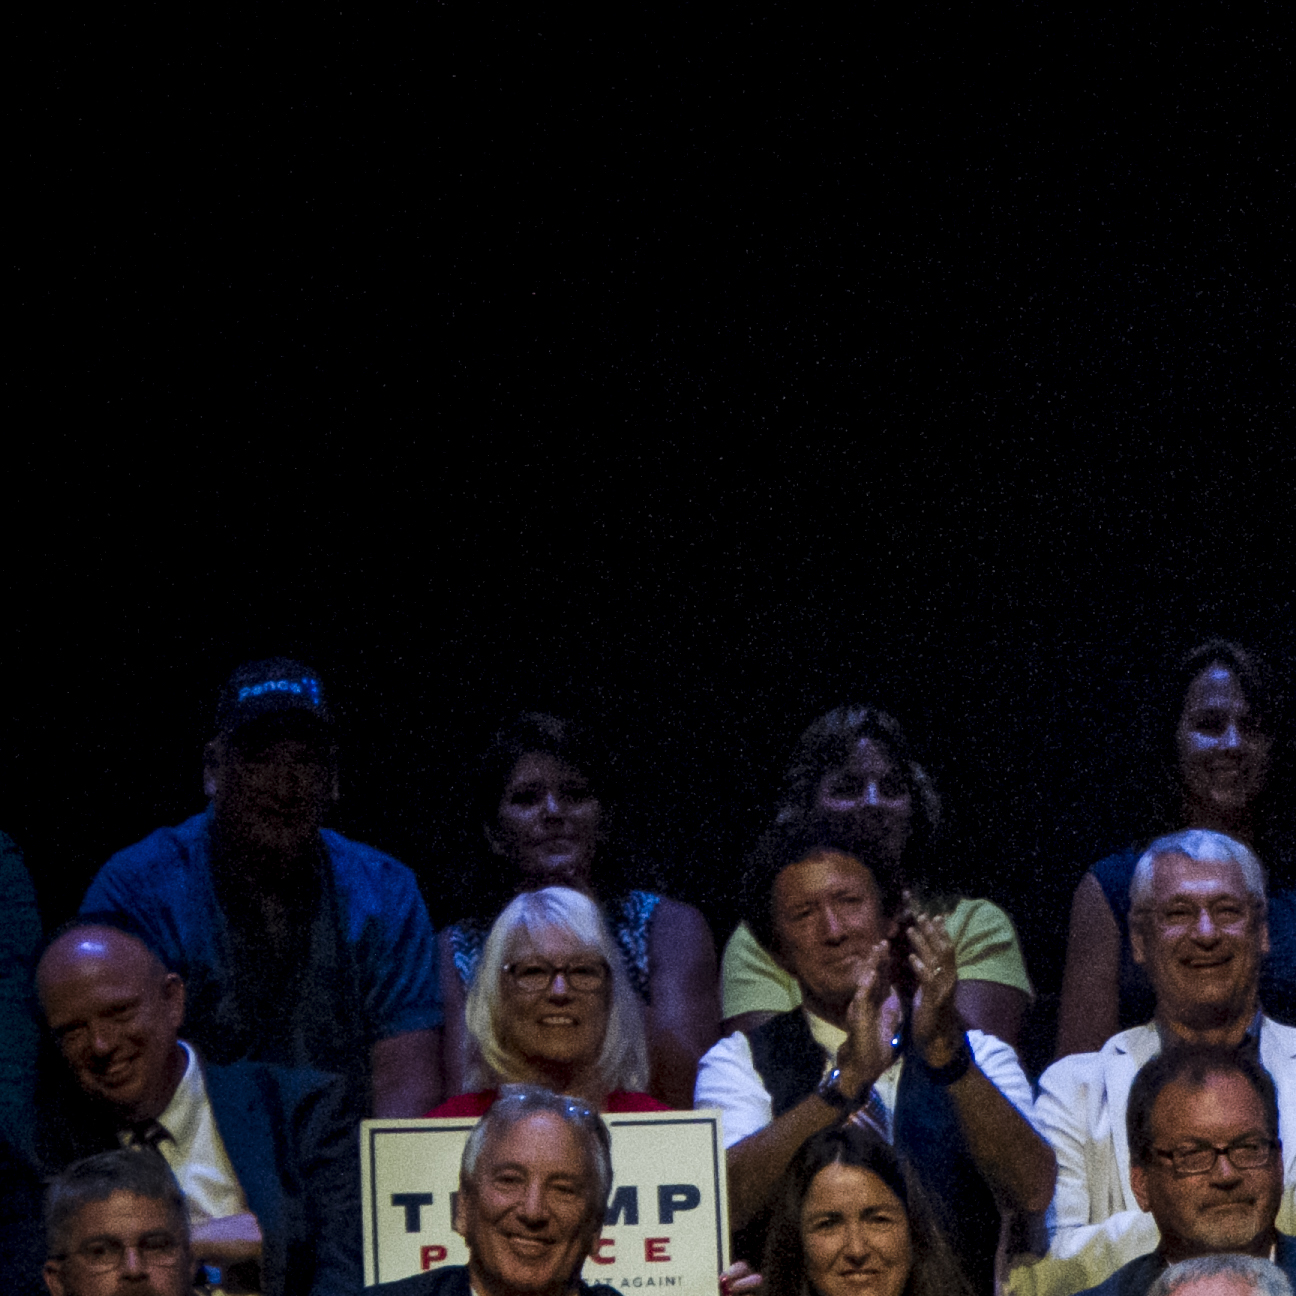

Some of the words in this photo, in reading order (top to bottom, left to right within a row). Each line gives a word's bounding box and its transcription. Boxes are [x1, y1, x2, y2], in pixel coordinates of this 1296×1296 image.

[390, 1184, 701, 1233] TMP
[420, 1236, 671, 1270] PCE
[621, 1275, 683, 1288] AGAIN!
